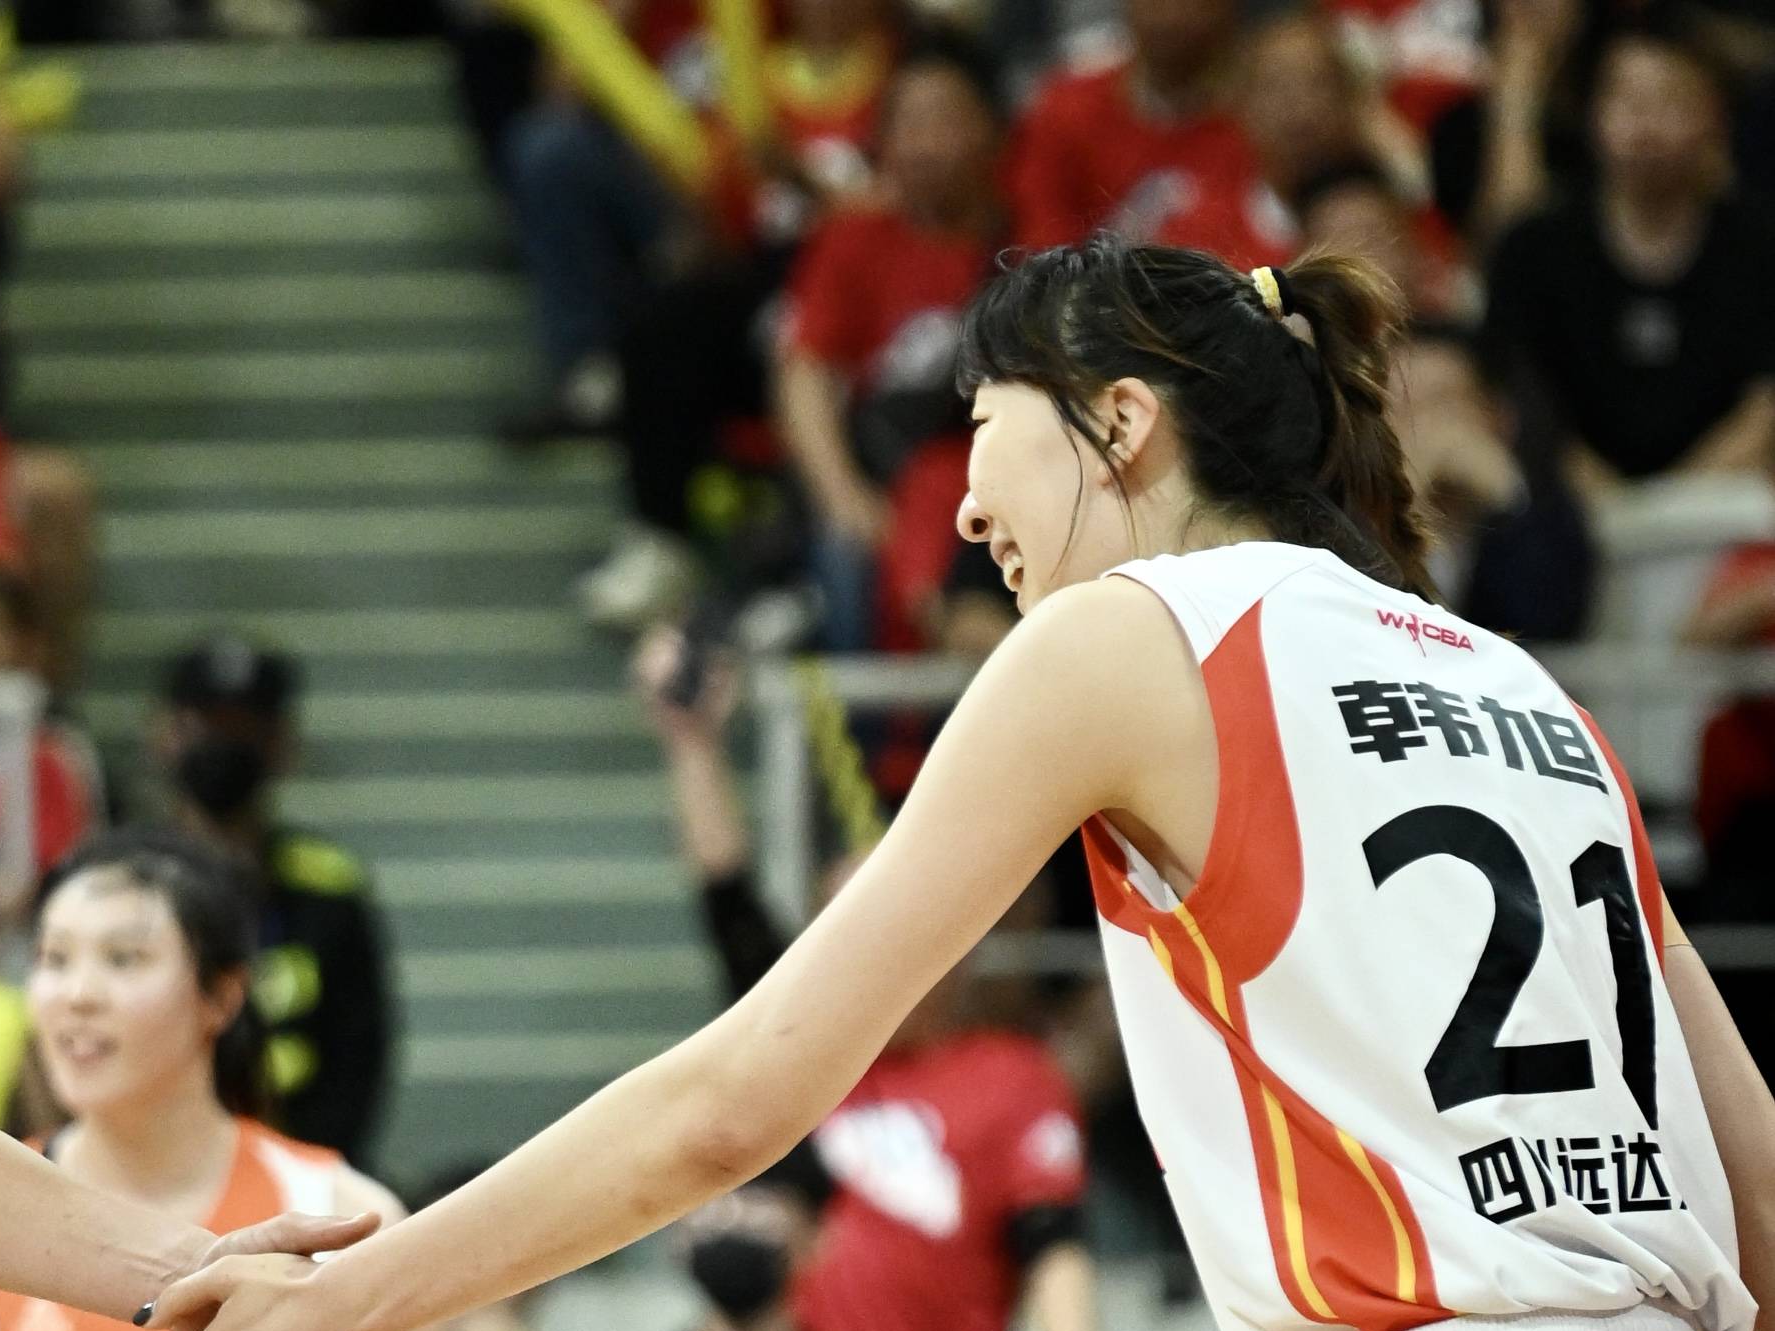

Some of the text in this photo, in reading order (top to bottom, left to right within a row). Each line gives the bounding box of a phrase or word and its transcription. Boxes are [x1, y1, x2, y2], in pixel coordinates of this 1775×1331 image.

[1376, 607, 1475, 653] WCBA
[1331, 679, 1609, 796] 韩旭
[1361, 804, 1659, 1131] 21
